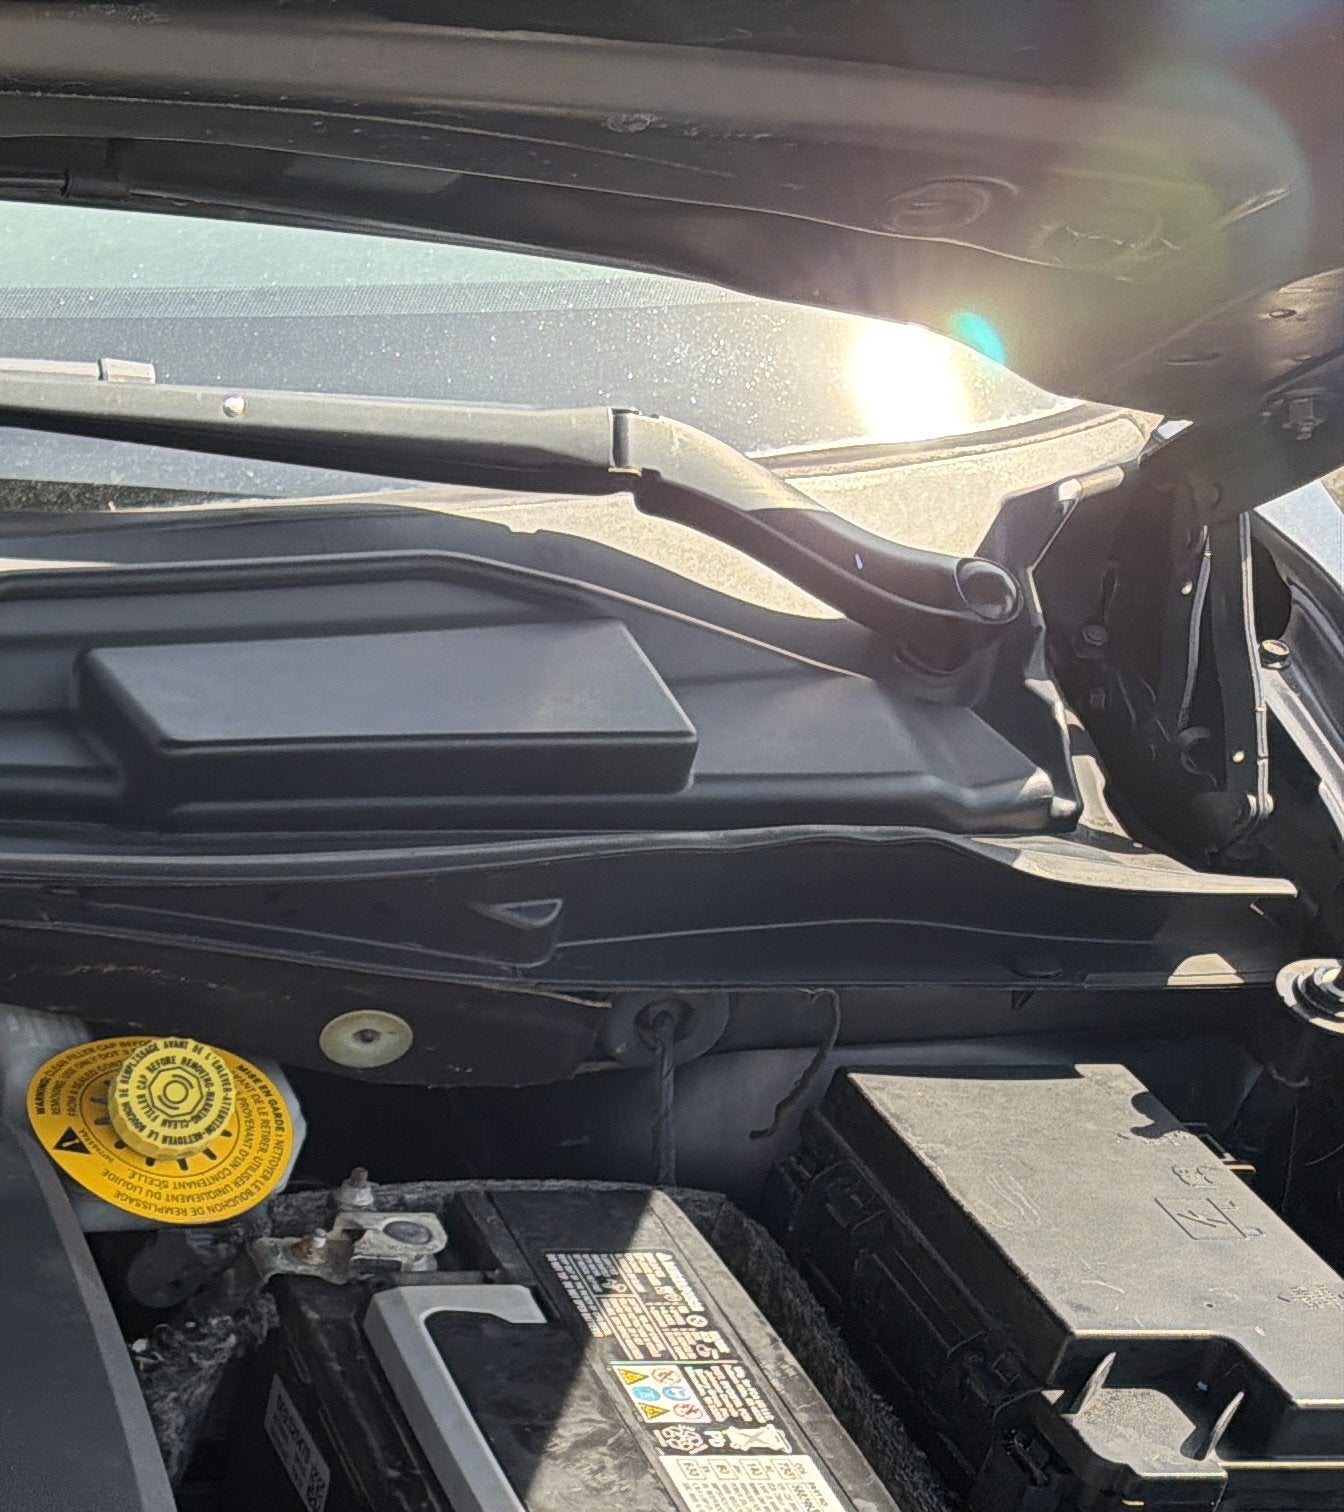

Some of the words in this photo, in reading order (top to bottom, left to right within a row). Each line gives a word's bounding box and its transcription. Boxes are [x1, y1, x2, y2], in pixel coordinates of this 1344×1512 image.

[164, 1040, 188, 1048] AVANT
[192, 1045, 204, 1054] DE
[46, 1060, 67, 1076] CLEAN
[67, 1047, 94, 1060] FILLER
[120, 1042, 160, 1084] REMPLISSAGE
[146, 1056, 176, 1074] BEFORE
[136, 1074, 148, 1090] CAP
[237, 1064, 262, 1084] MISE
[119, 1088, 129, 1097] DE
[260, 1083, 272, 1096] EN
[136, 1093, 160, 1122] FILLER
[251, 1094, 264, 1106] DE
[257, 1106, 268, 1117] LE
[268, 1098, 285, 1132] GARDE
[237, 1097, 255, 1151] PROVENANT
[147, 1130, 159, 1140] LE
[265, 1140, 285, 1181] NETTOYER
[101, 1169, 142, 1194] LIQUIDE
[172, 1167, 232, 1190] CONTENANT
[234, 1156, 264, 1188] UTILISER
[145, 1189, 162, 1200] DU
[166, 1184, 234, 1204] UNIQUEMENT
[250, 1179, 265, 1192] LE
[113, 1190, 187, 1216] REMPLISSAGE
[207, 1186, 256, 1214] BOUCHON
[191, 1207, 206, 1216] DE
